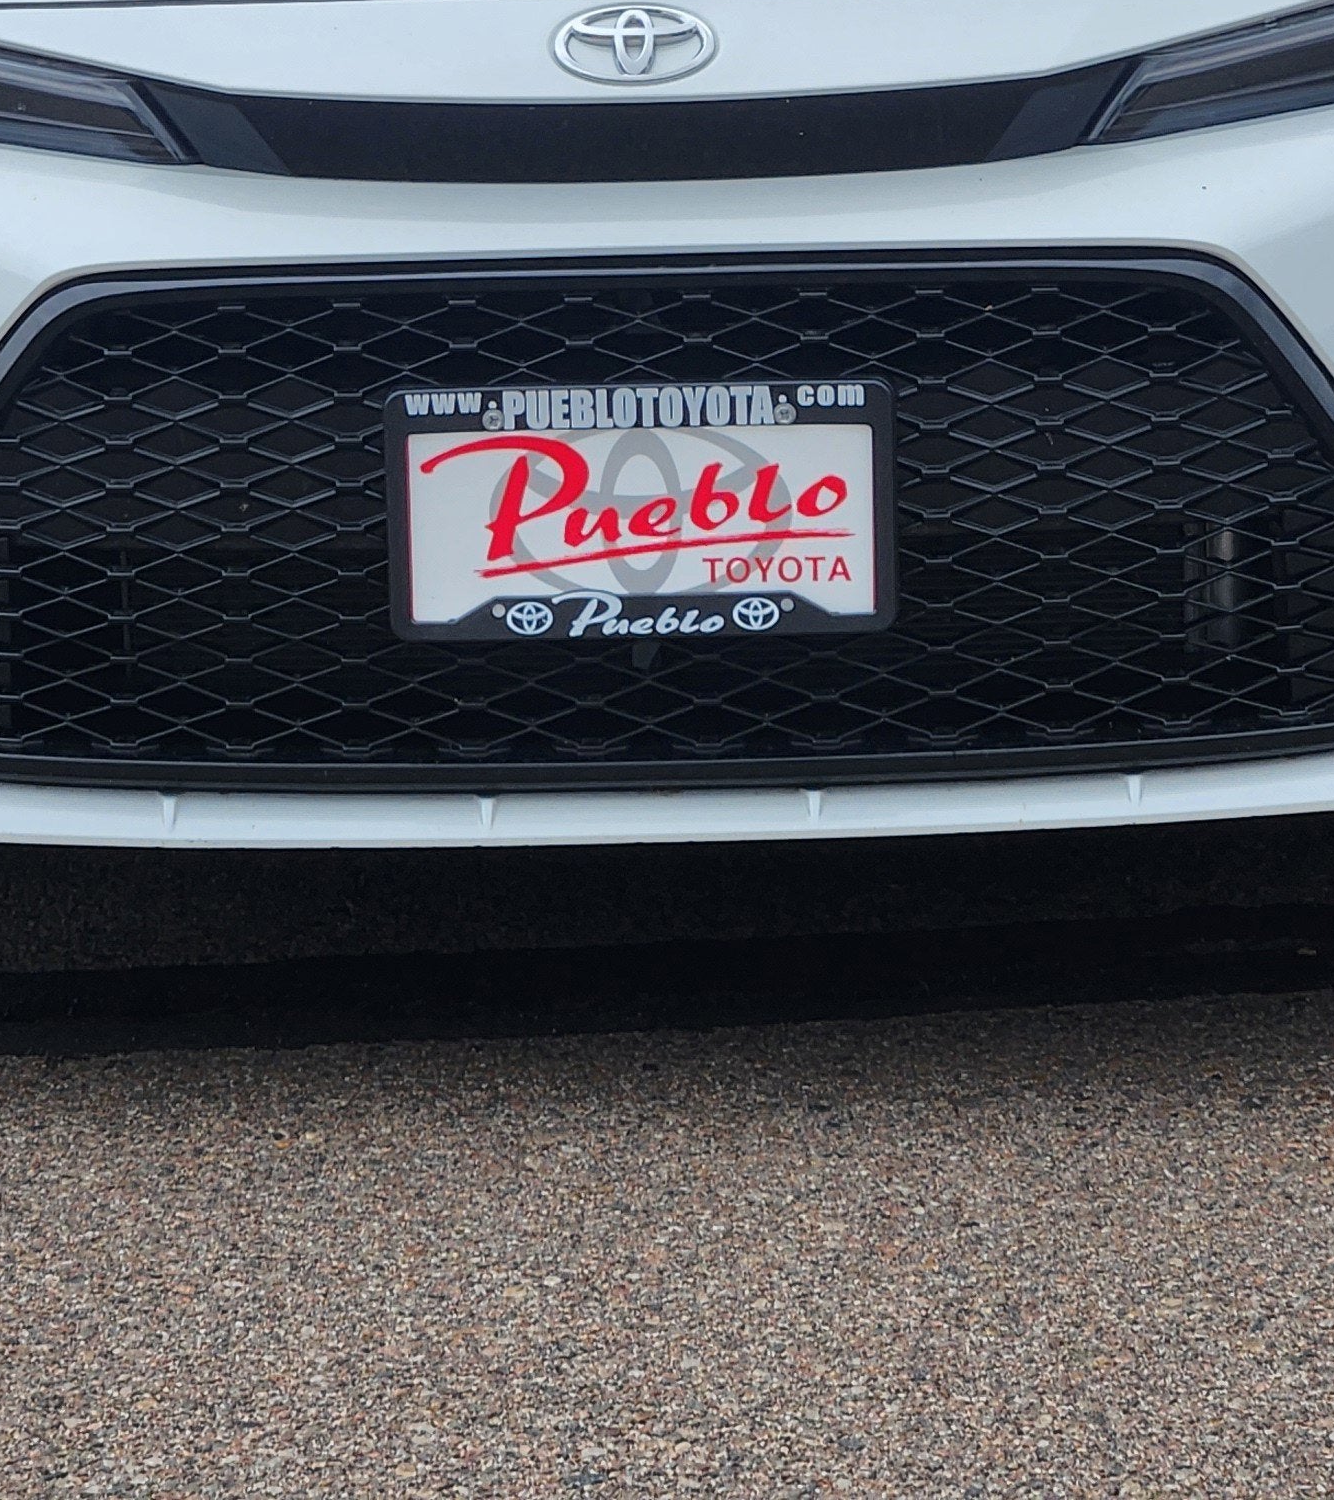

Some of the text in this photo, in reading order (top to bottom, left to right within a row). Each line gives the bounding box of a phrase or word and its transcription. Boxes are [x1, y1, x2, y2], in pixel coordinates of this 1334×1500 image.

[420, 435, 848, 561] Pueblo
[702, 556, 852, 583] TOYOTA
[552, 591, 725, 637] Pueblo
